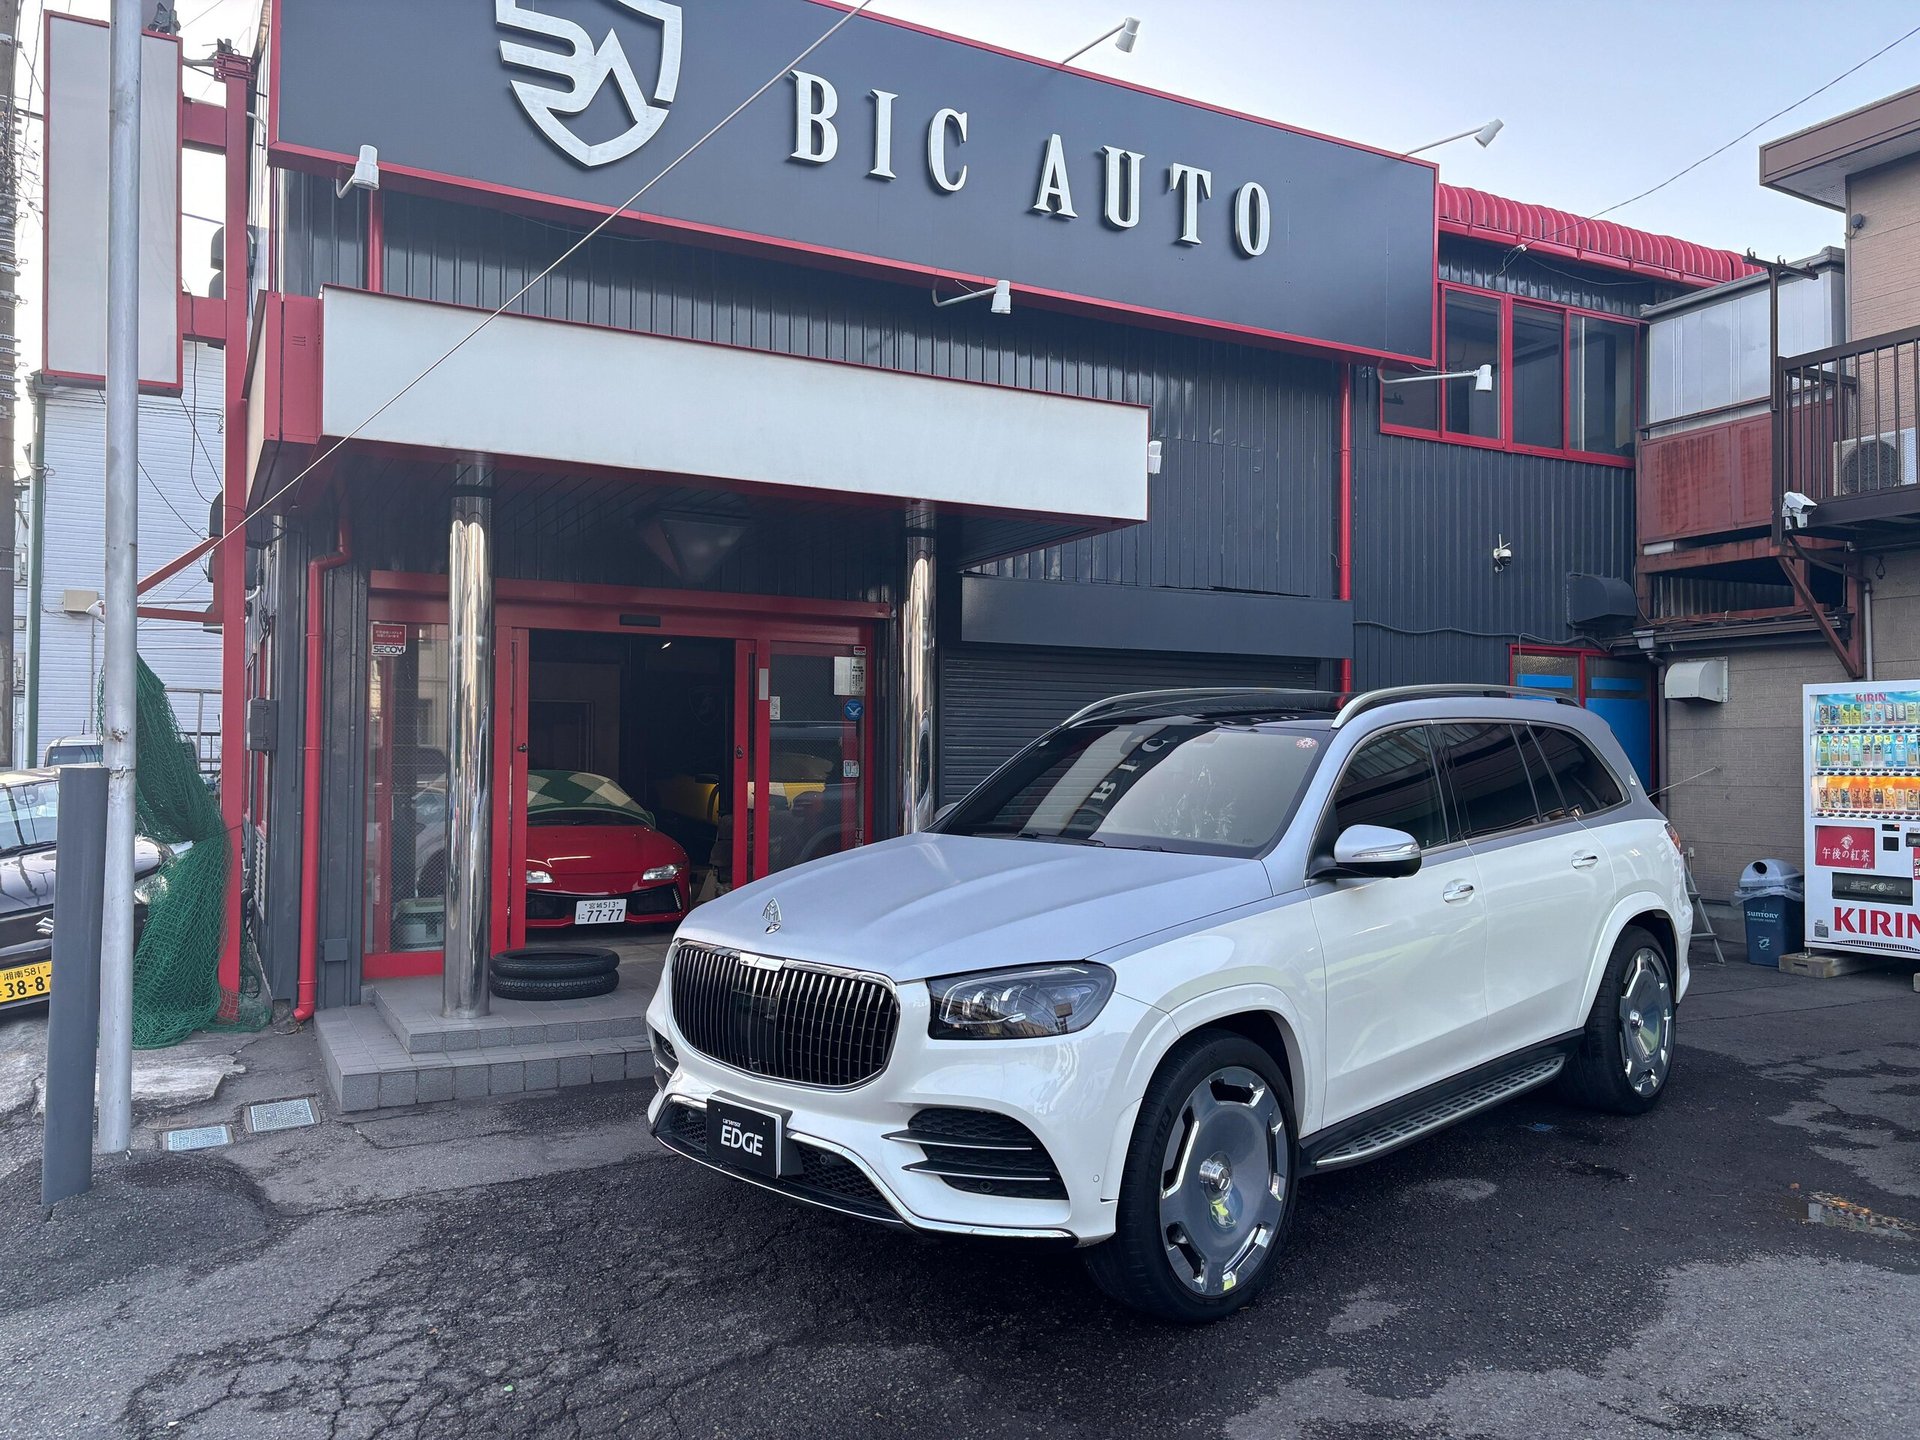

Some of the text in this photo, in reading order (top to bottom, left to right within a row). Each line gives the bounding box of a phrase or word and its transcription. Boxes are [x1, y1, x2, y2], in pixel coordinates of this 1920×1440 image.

[789, 69, 1271, 257] BIC AUTO
[374, 646, 404, 654] SECOM
[1855, 692, 1887, 703] KIRIN
[1821, 847, 1870, 862] 午後の紅茶
[587, 909, 623, 922] 77-77
[1747, 911, 1779, 919] SUNTORY
[1834, 906, 1920, 939] KIRIN
[4, 974, 51, 998] 38-8
[721, 1125, 763, 1156] EDGE
